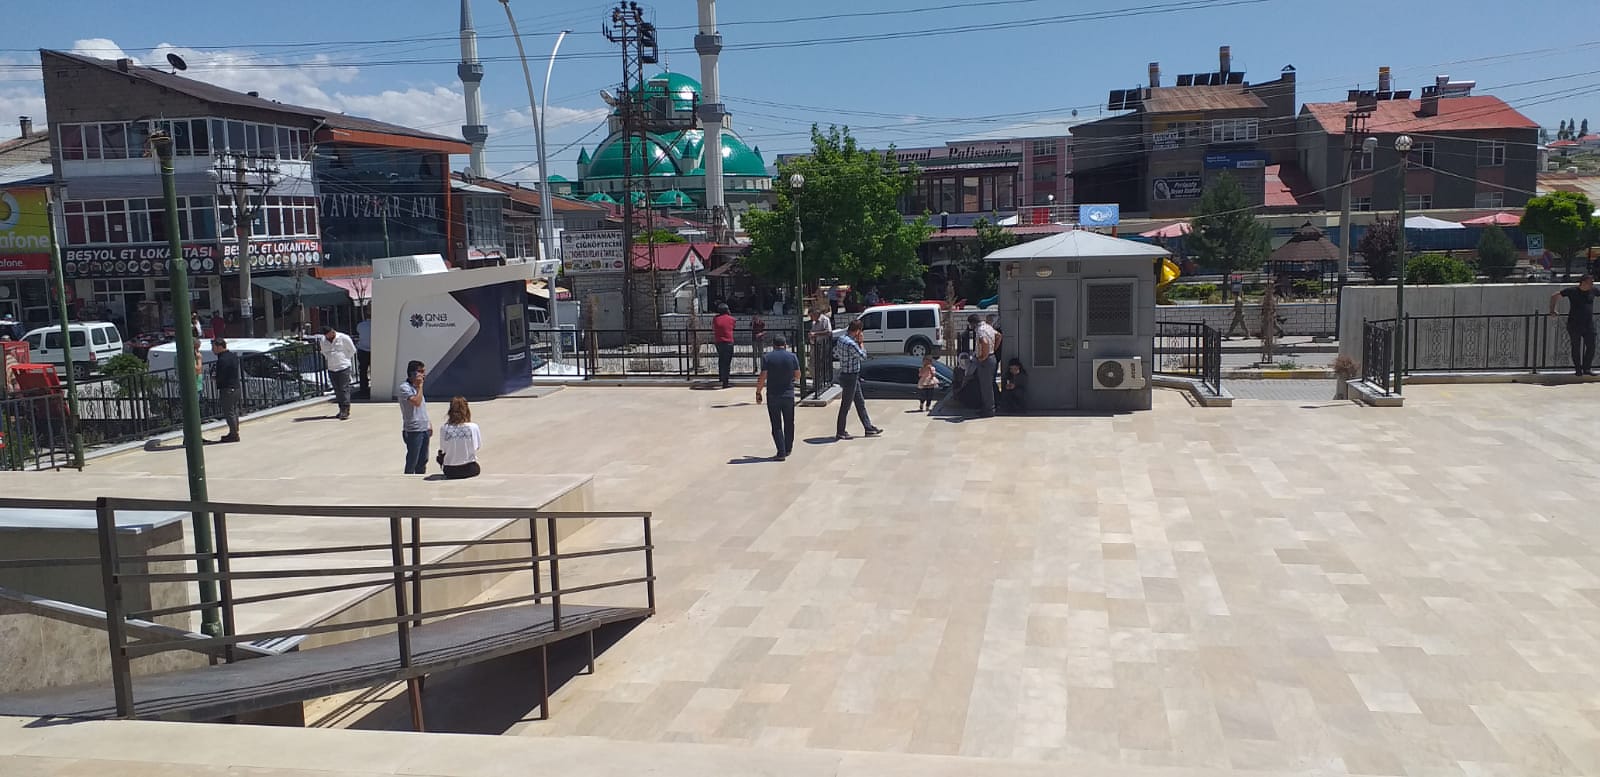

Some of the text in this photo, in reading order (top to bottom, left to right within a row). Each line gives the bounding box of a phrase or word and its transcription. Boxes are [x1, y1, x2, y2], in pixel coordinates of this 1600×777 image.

[319, 192, 401, 218] YAVUZLAR
[119, 248, 137, 260] ET
[139, 246, 213, 260] LOKATASI
[261, 243, 272, 254] ET
[424, 313, 448, 322] QNB
